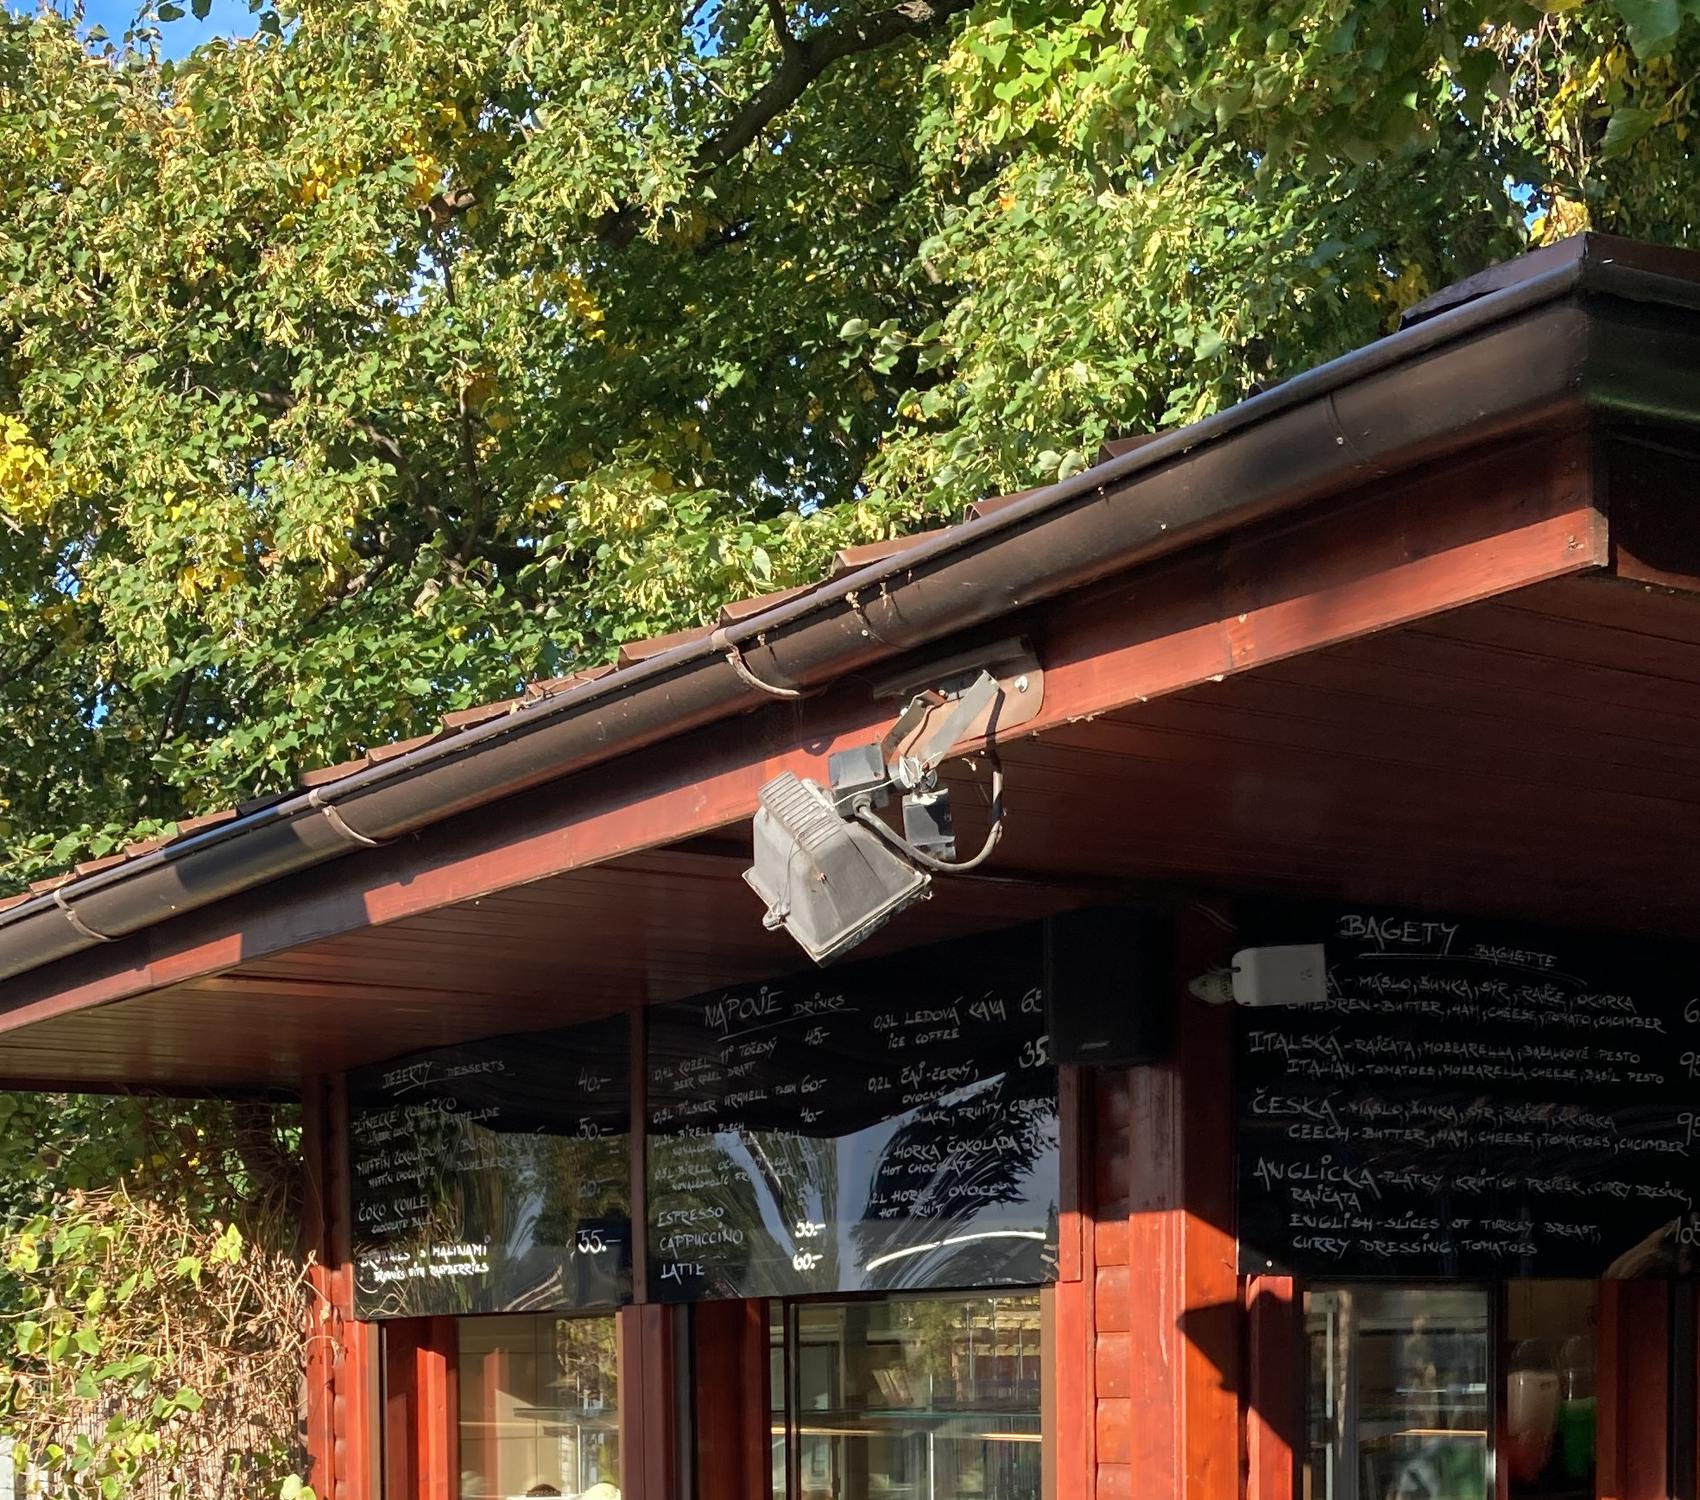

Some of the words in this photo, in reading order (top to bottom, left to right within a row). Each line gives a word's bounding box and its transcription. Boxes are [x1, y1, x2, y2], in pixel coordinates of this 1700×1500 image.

[1340, 915, 1460, 954] BAGETY
[704, 986, 784, 1034] NÁPOJE
[793, 992, 845, 1016] DRINKS
[905, 996, 963, 1026] LEDOVÁ
[969, 990, 1006, 1021] KÁVA
[1577, 994, 1638, 1014] OKURKA
[916, 1028, 960, 1045] COFFEE
[1600, 1017, 1667, 1034] CUCUMBER
[739, 1036, 777, 1058] TOČENÝ
[1248, 1026, 1344, 1061] ITALSKÁ
[1600, 1050, 1640, 1064] PESTO
[446, 1061, 505, 1079] DESSERTS
[1287, 1055, 1354, 1080] ITALIAN
[1628, 1071, 1664, 1084] PESTO
[1252, 1084, 1343, 1131] ČESKÁ
[893, 1136, 941, 1161] HORKÁ
[1619, 1138, 1689, 1157] CUCUMBER
[881, 1165, 903, 1177] HOT
[1252, 1154, 1382, 1200] ANGLICKÁ
[1290, 1183, 1361, 1213] RAJČATA
[657, 1206, 724, 1227] ESPRESSO
[879, 1207, 900, 1218] HOT
[1288, 1212, 1373, 1231] ENGLISH
[1384, 1210, 1441, 1230] SLICES
[1451, 1219, 1473, 1230] OF
[1480, 1219, 1536, 1238] TURKEY
[660, 1221, 744, 1260] CAPPUCCINO
[1292, 1235, 1352, 1259] CURRY
[1460, 1239, 1538, 1257] TOMATOES
